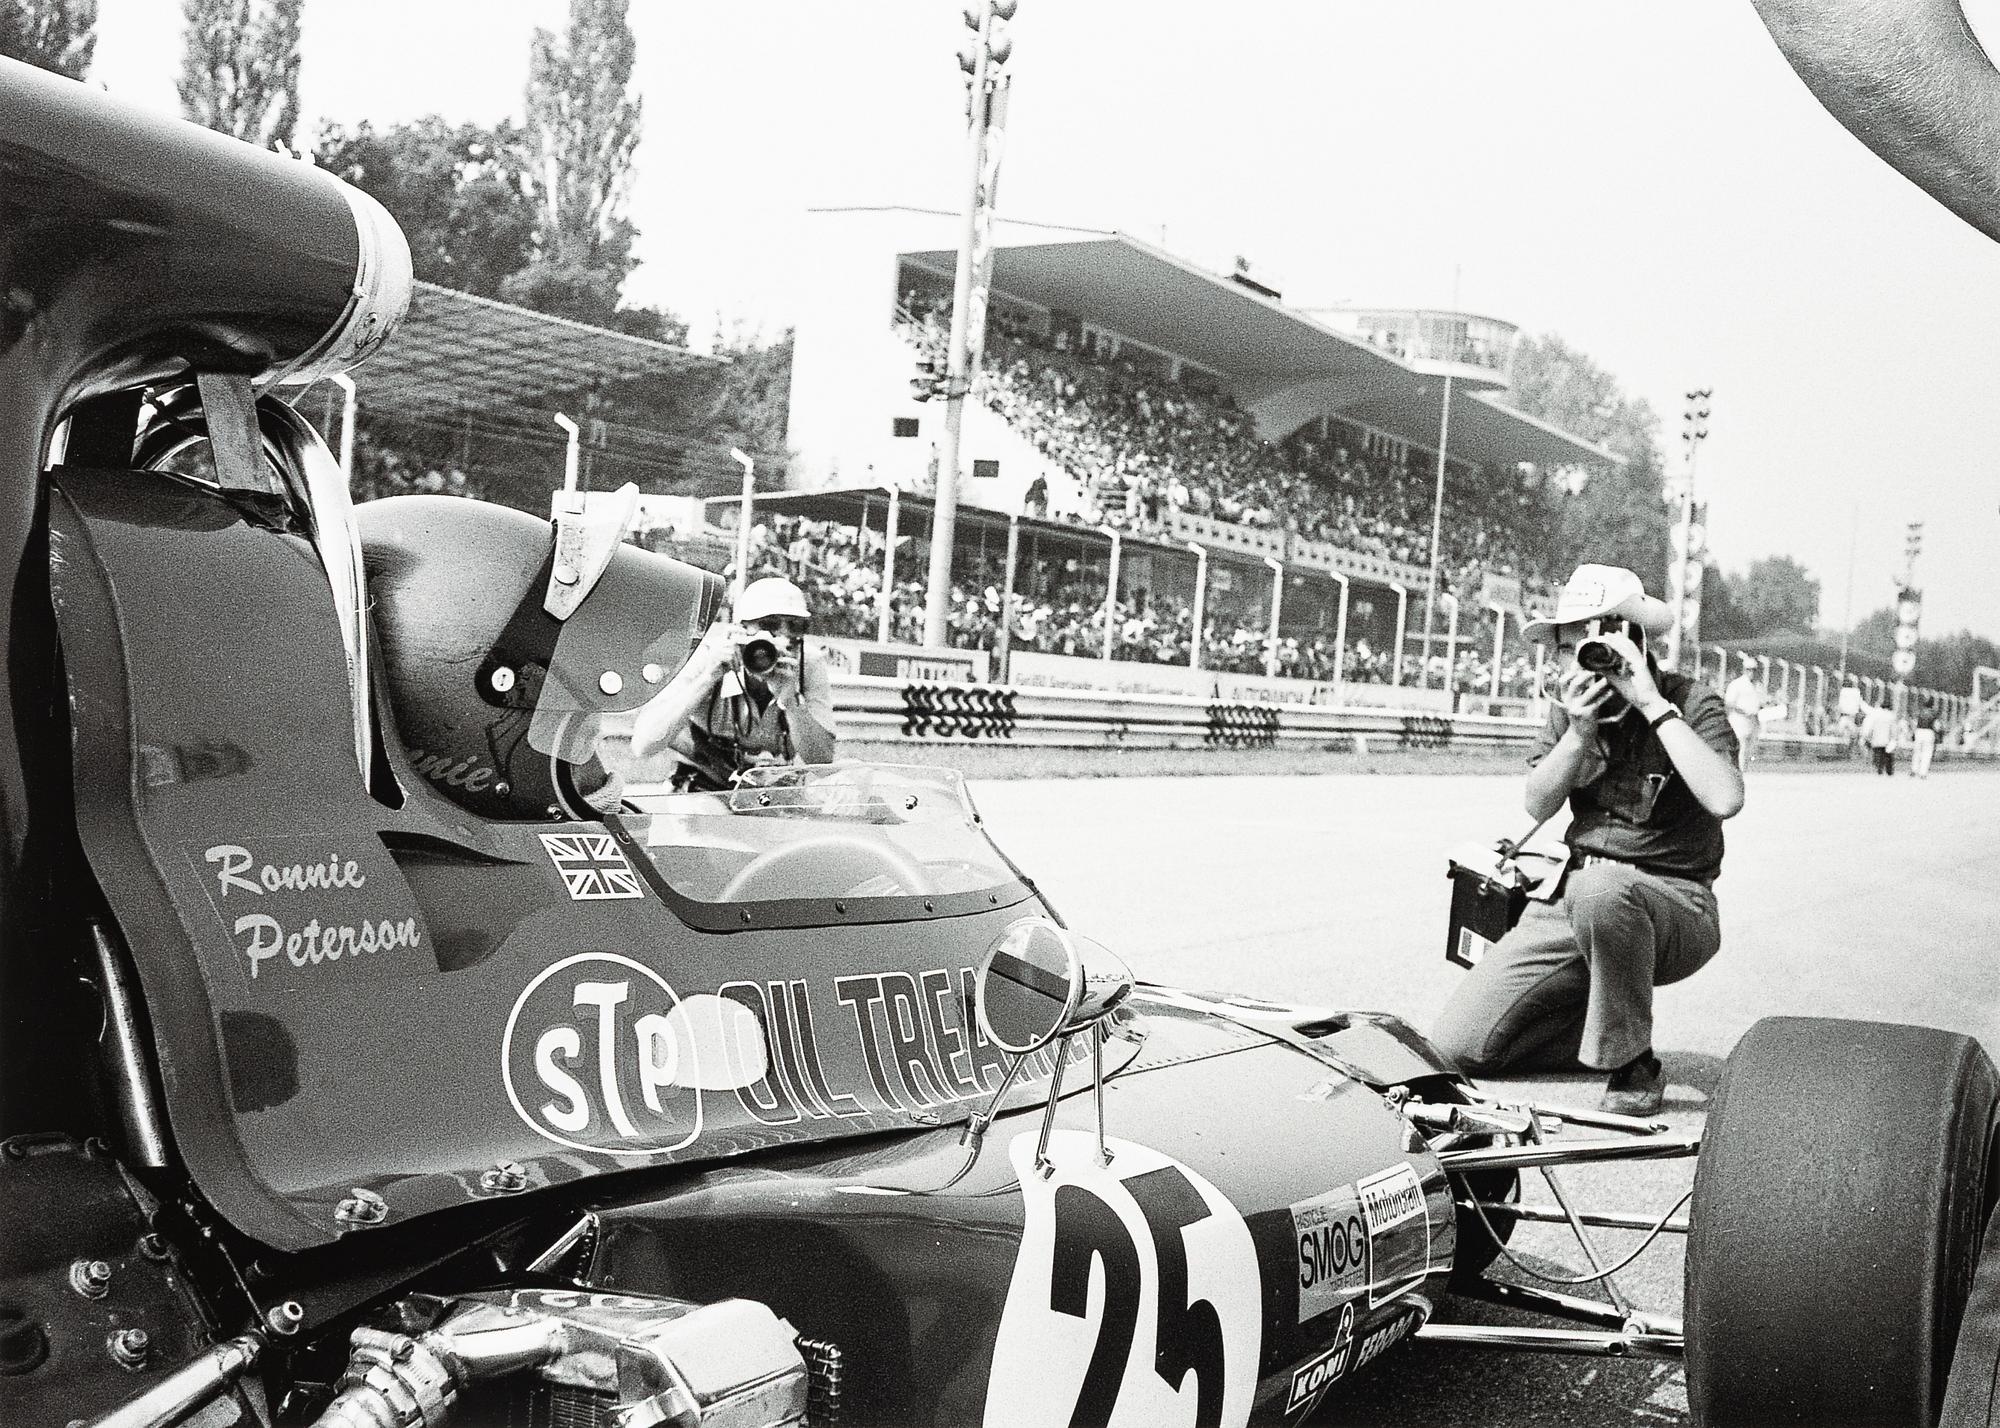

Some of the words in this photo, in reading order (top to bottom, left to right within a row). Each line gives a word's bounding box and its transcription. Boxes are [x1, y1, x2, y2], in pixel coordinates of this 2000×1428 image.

[204, 843, 366, 897] Ronnie
[234, 913, 422, 980] Peterson
[534, 981, 679, 1138] STP
[718, 976, 873, 1127] OIL
[1299, 1214, 1365, 1290] SMOG
[1050, 1164, 1226, 1428] 25
[1293, 1348, 1347, 1402] KONI
